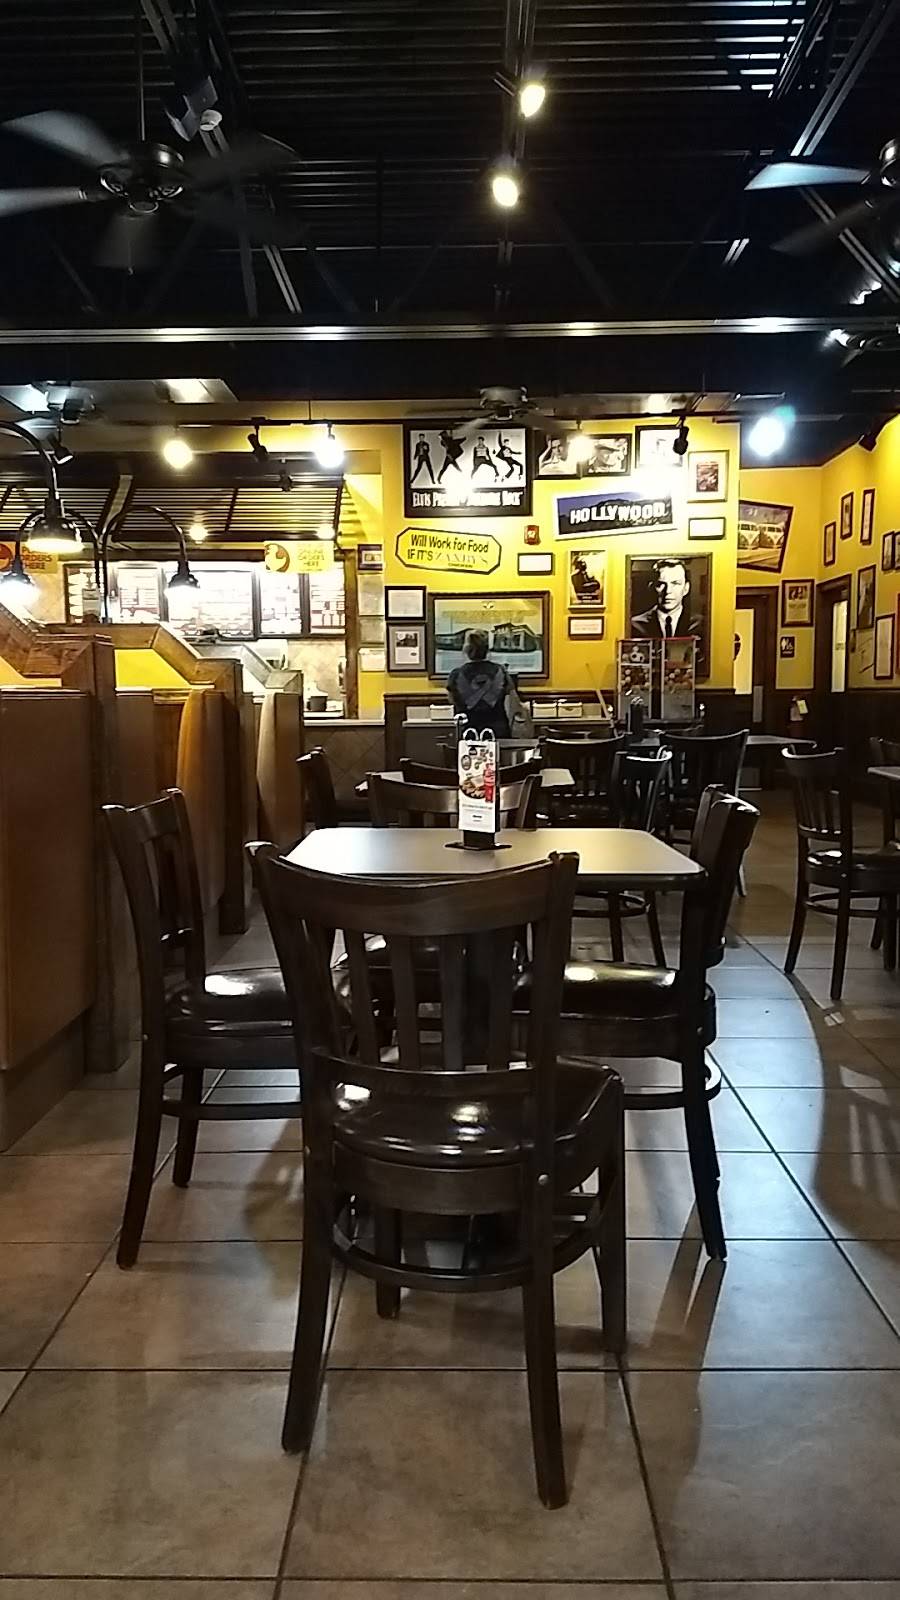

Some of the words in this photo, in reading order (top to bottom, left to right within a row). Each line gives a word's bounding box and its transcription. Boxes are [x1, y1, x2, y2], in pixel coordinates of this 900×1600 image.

[570, 501, 667, 525] HOLLYWOOD
[411, 534, 428, 547] Will
[429, 536, 451, 549] Work
[453, 537, 467, 551] for
[468, 539, 489, 553] Food
[407, 549, 416, 560] IF
[417, 549, 434, 561] IT'S
